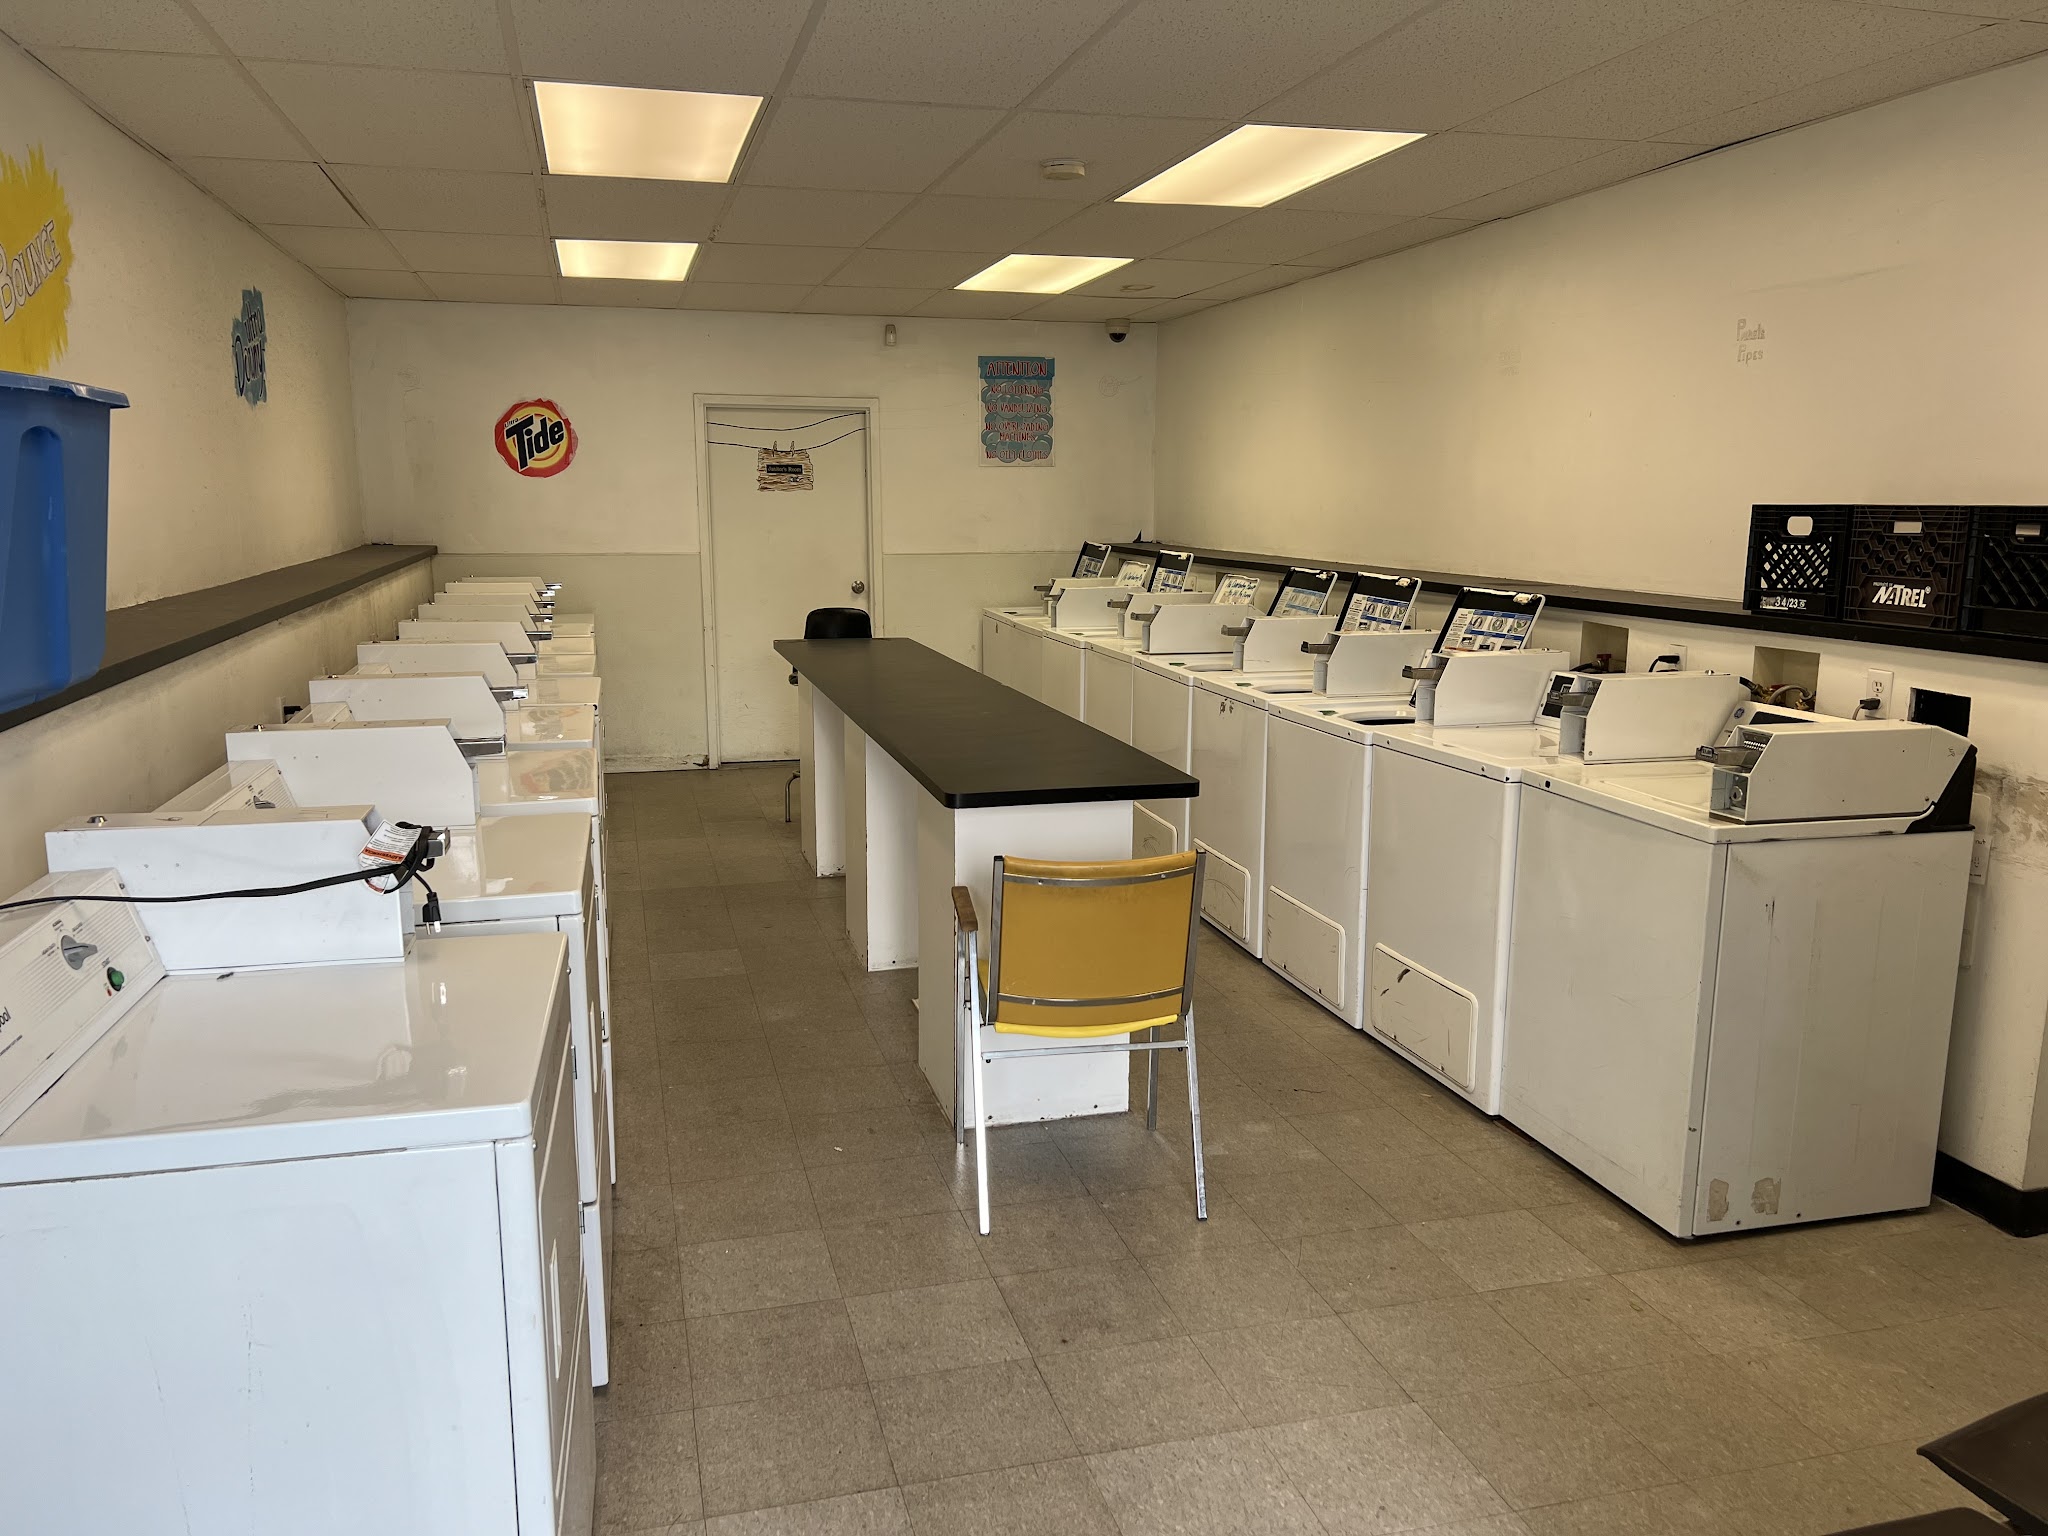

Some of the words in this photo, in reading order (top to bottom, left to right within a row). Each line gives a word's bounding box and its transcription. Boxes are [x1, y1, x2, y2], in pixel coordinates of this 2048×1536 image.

[986, 361, 1048, 377] ATTENTION
[991, 385, 1002, 394] NO
[987, 403, 998, 413] NO
[985, 421, 998, 431] NO
[504, 414, 565, 471] Tide
[986, 449, 998, 459] NO
[1871, 584, 1927, 609] NATREL
